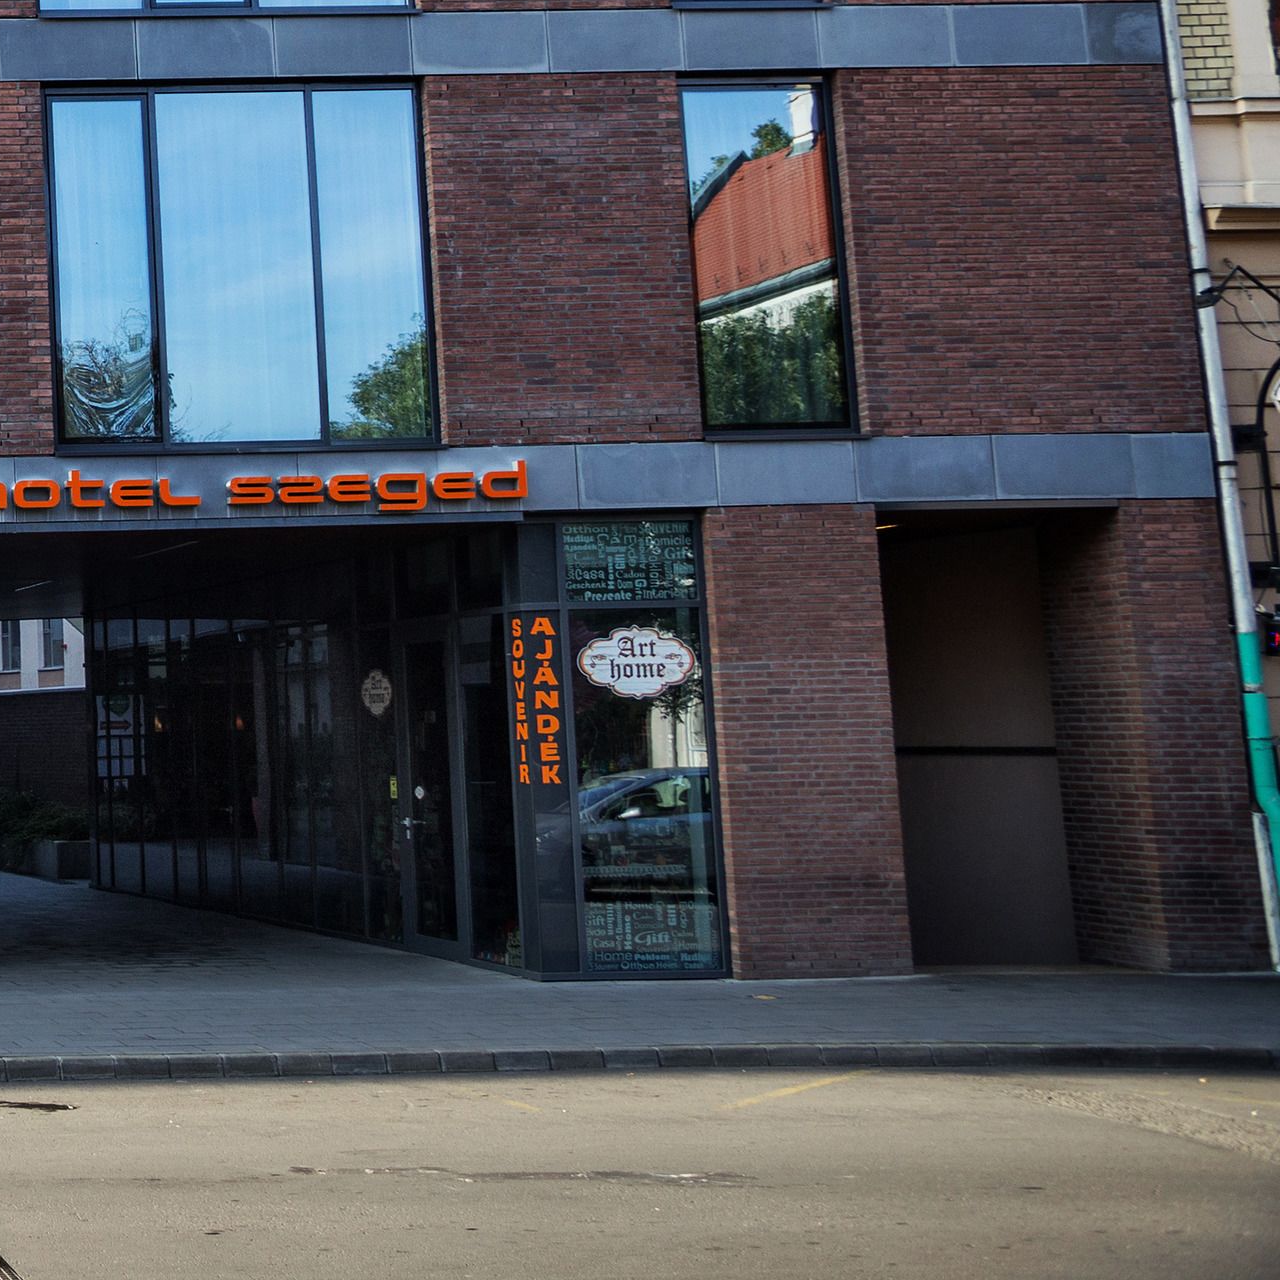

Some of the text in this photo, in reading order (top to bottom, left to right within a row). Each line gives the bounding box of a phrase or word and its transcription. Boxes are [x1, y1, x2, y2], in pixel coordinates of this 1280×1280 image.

[227, 460, 528, 511] szeged
[562, 524, 608, 534] Otthon
[575, 568, 605, 580] Casa
[565, 580, 607, 590] Geschenk
[584, 591, 632, 601] Presente
[617, 636, 656, 658] Art
[609, 658, 666, 682] home
[512, 618, 530, 785] SOUVENIR
[530, 617, 561, 785] AJÁNDÉK
[594, 951, 633, 961] Home
